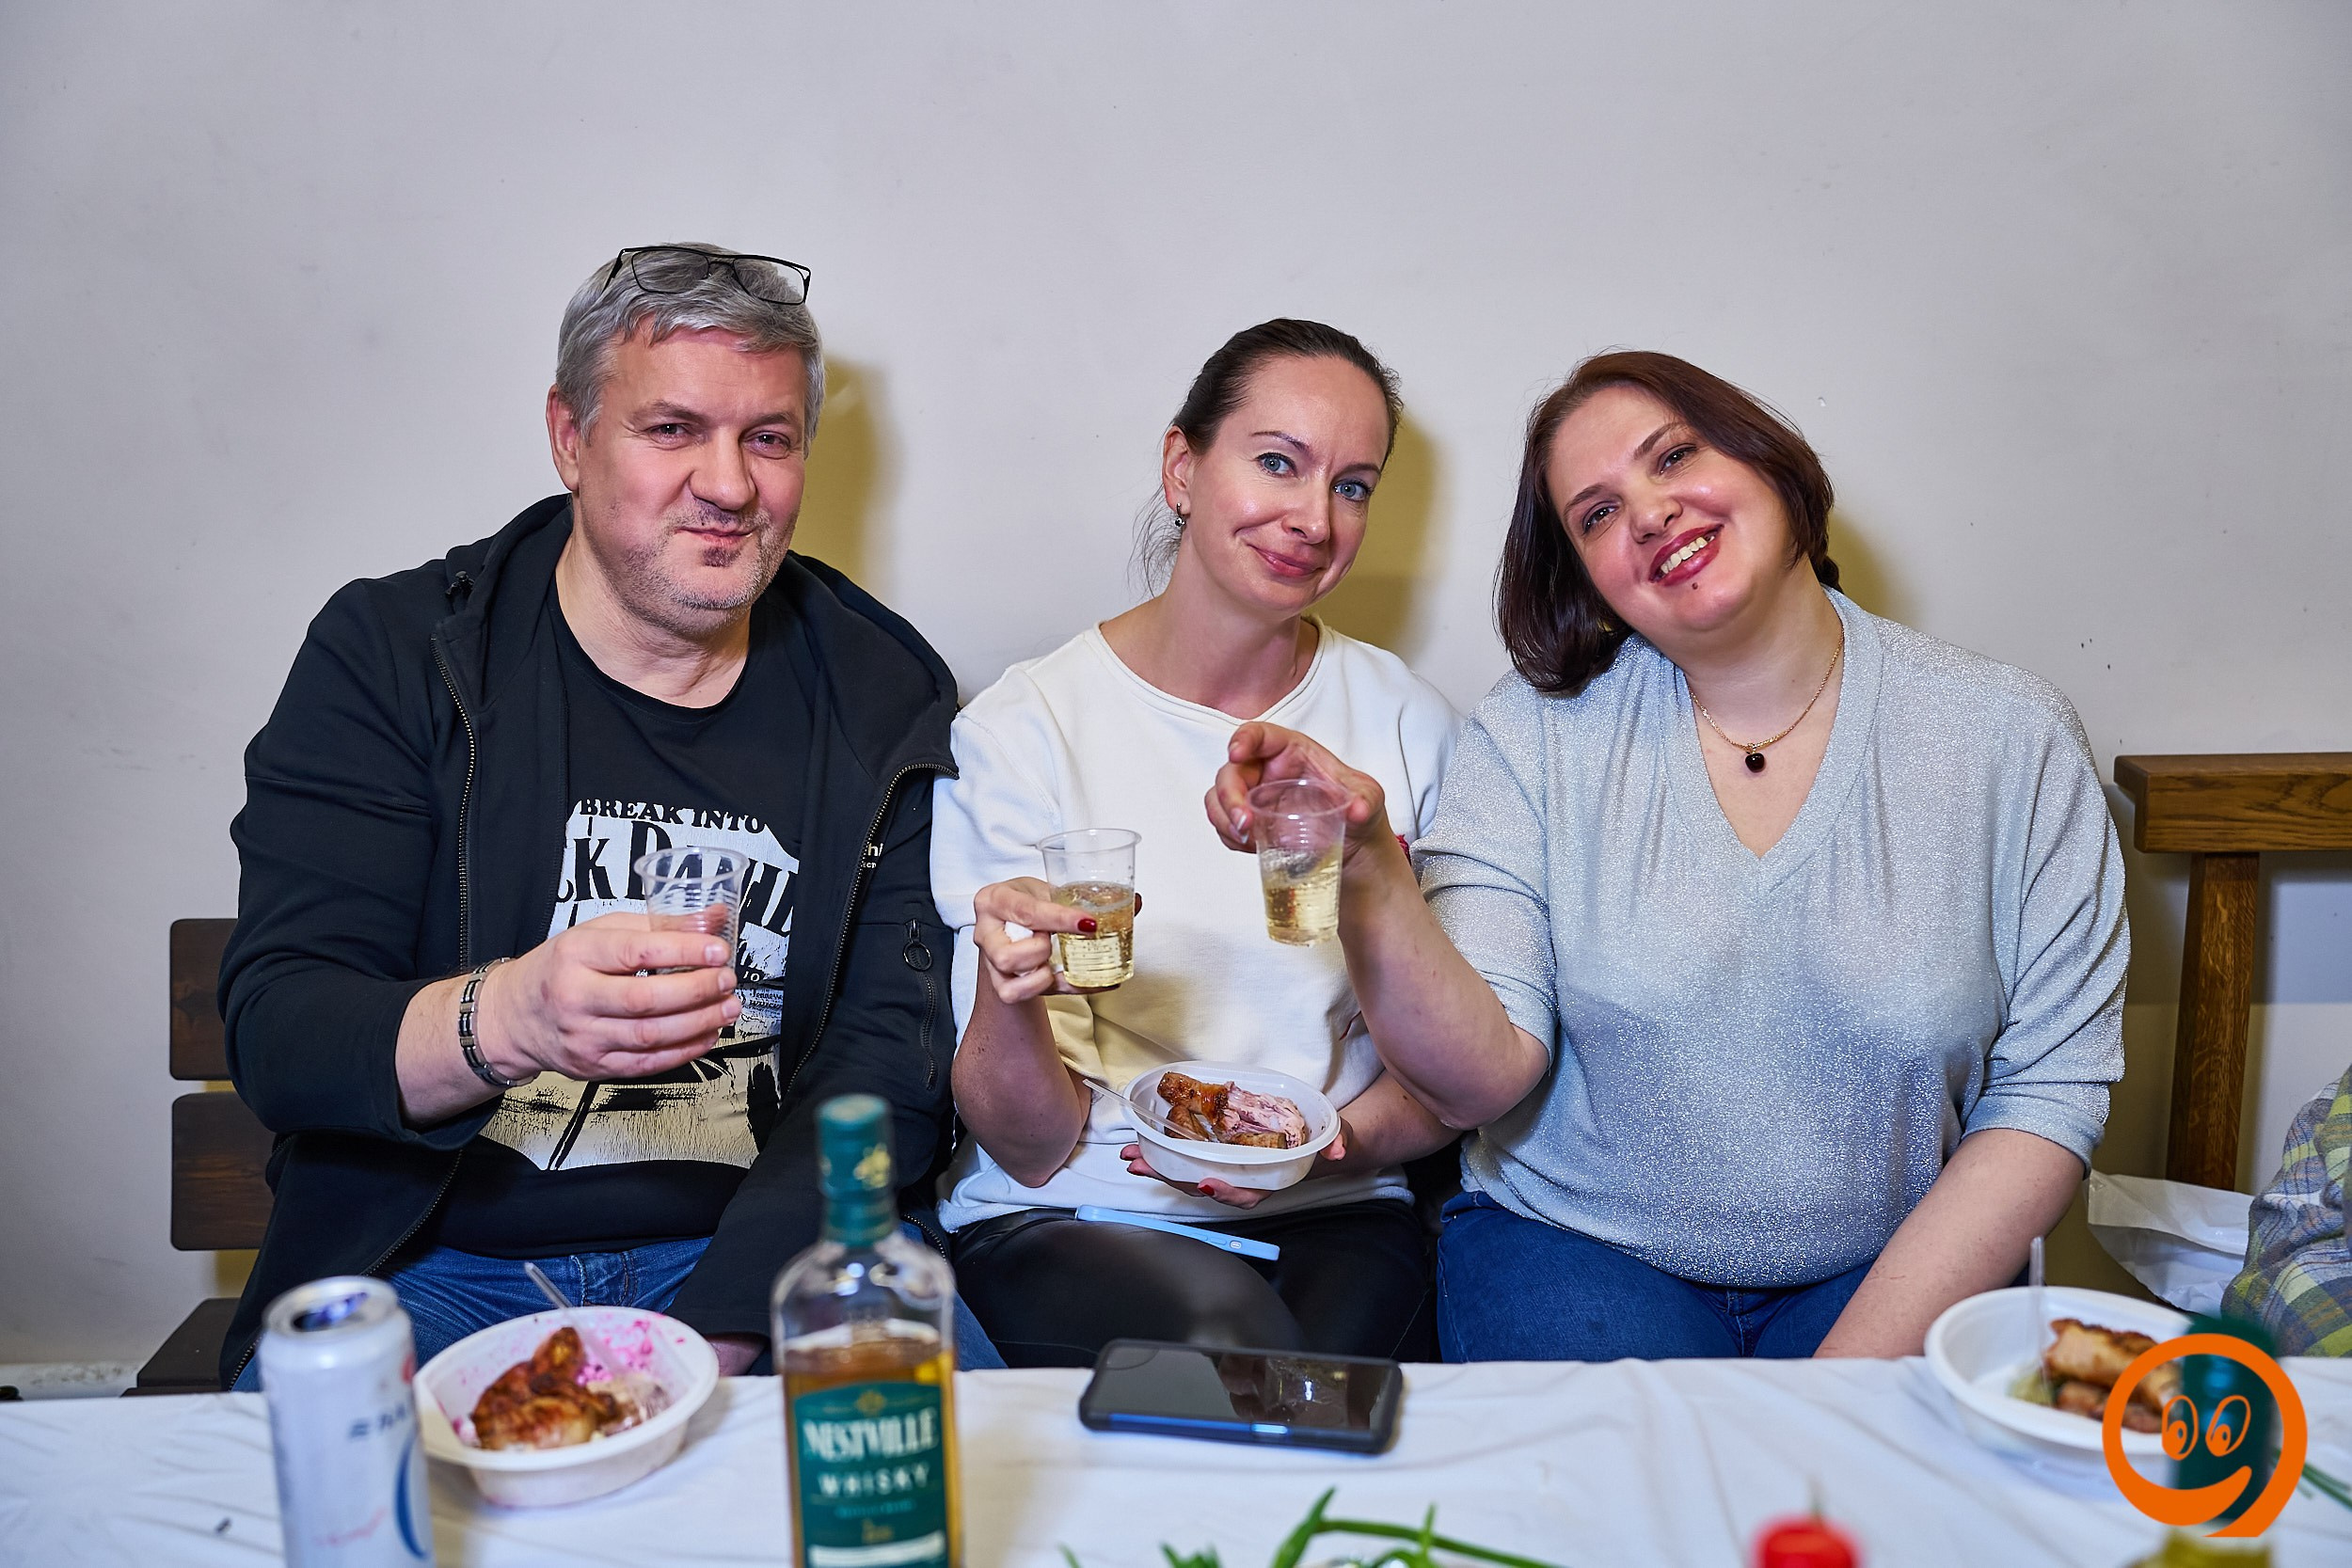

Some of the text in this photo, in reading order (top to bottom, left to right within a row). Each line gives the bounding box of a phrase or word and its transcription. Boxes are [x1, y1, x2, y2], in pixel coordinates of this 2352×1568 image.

[580, 799, 765, 834] BREAK INTO
[803, 1407, 937, 1463] NESTVILLE
[818, 1462, 930, 1497] WHISKY
